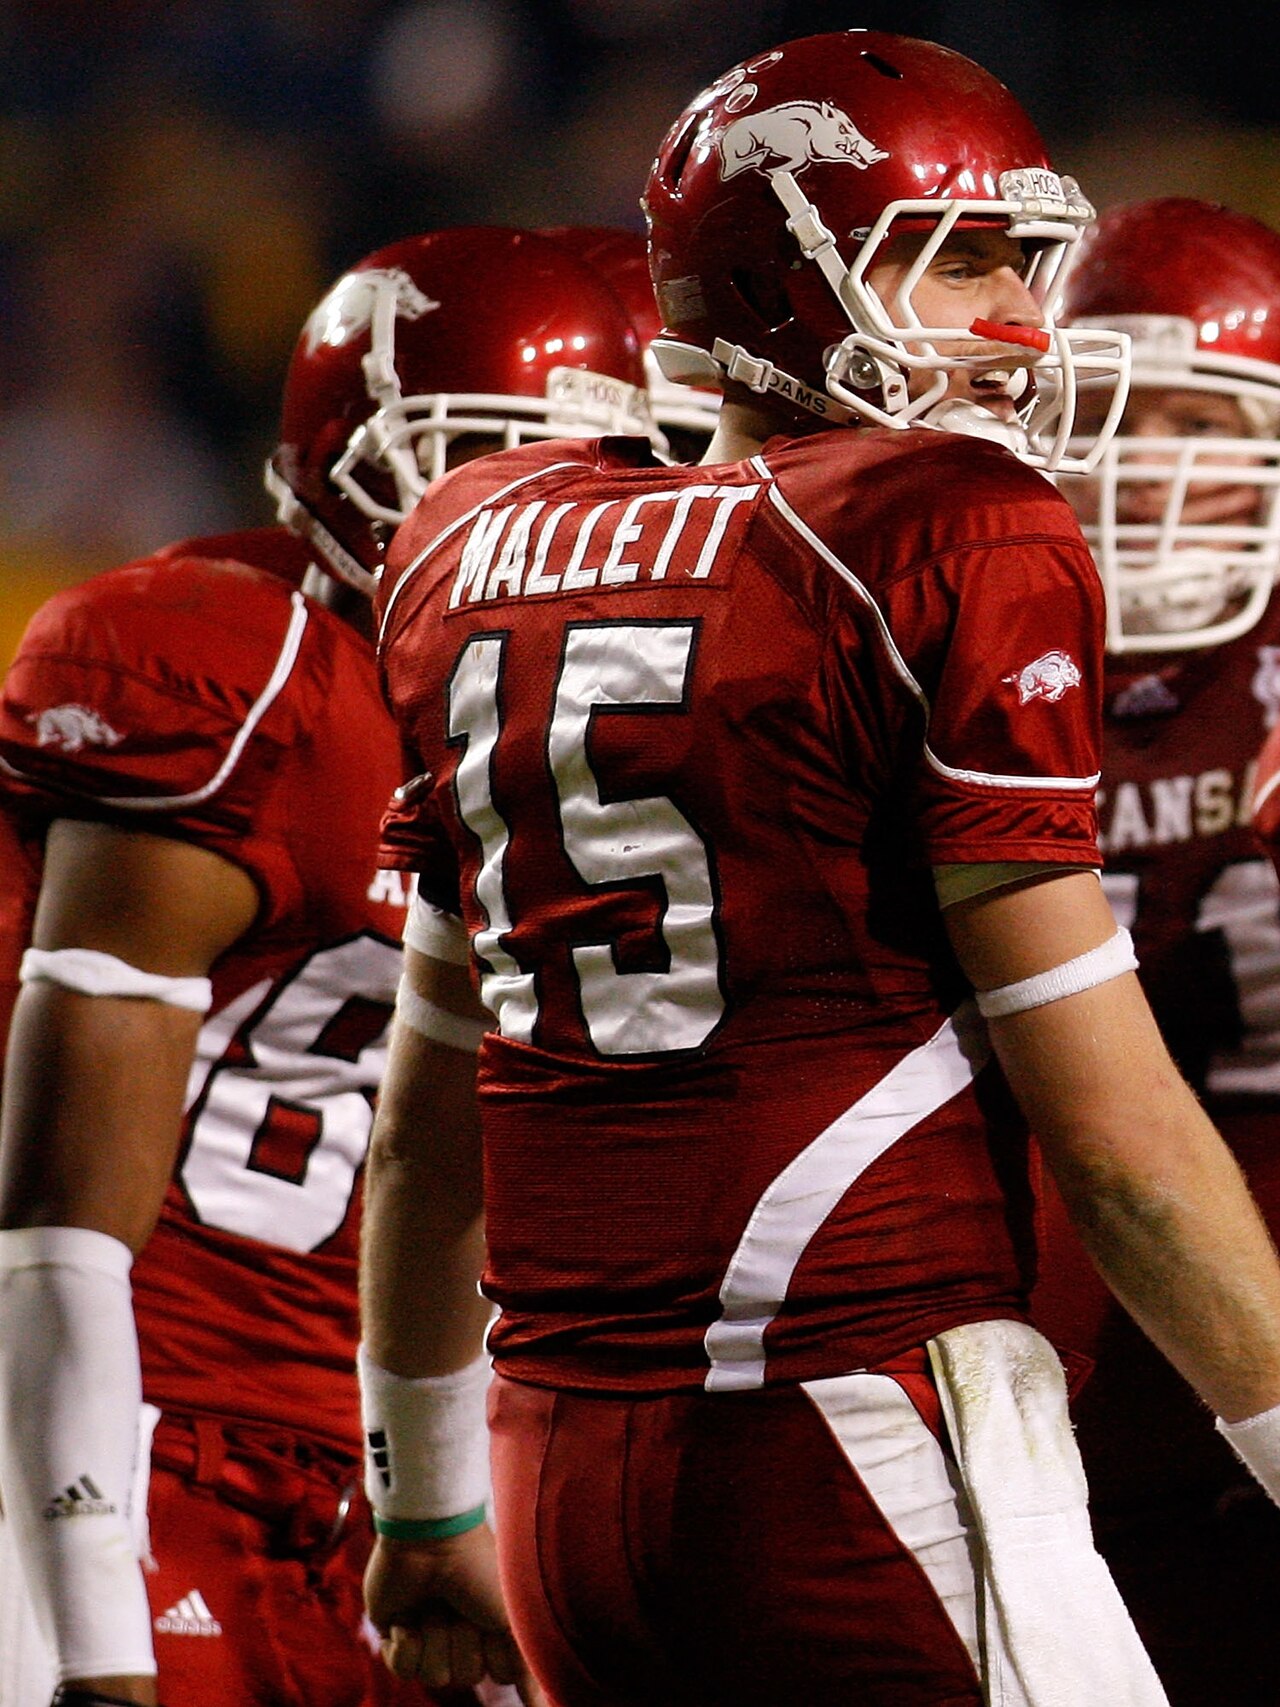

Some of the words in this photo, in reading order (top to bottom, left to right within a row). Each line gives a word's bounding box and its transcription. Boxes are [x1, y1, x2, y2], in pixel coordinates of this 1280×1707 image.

[1030, 173, 1060, 197] HOGS
[768, 370, 828, 415] DAMS
[448, 484, 761, 610] MALLETT
[1097, 762, 1255, 850] ANS
[448, 626, 724, 1055] 15
[367, 868, 418, 905] A
